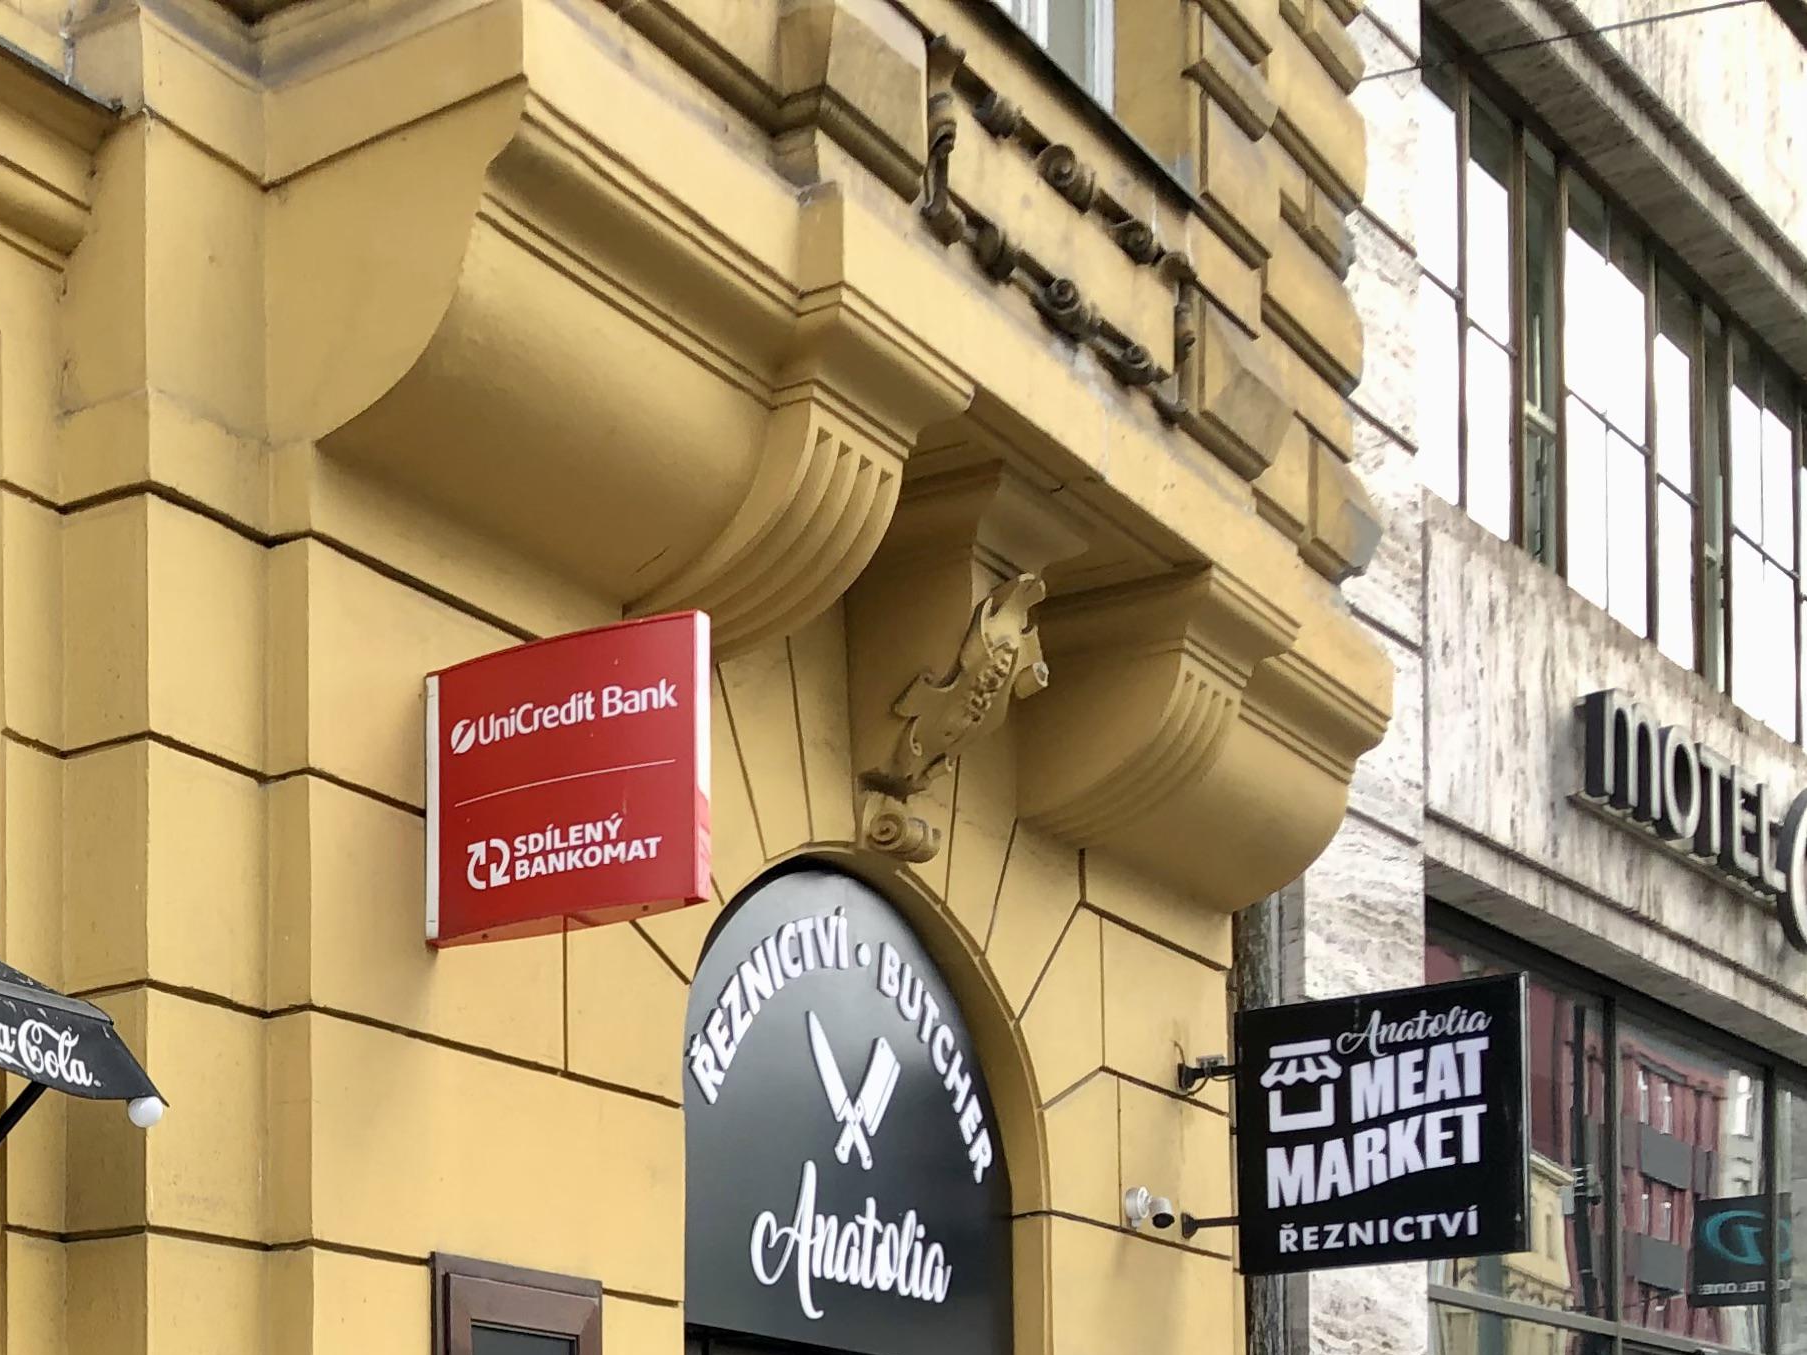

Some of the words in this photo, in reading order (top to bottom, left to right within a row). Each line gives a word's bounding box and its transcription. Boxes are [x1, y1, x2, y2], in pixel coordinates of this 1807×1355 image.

[479, 692, 595, 746] UniCredit
[601, 678, 679, 719] Bank
[513, 812, 624, 858] SDÍLENÝ
[514, 835, 663, 882] BANKOMAT
[685, 906, 850, 1105] ŘEZNICTVÍ
[877, 942, 993, 1184] BUTCHER
[1336, 1005, 1493, 1058] Anatolia
[1350, 1035, 1490, 1124] MEAT
[1265, 1103, 1488, 1210] MARKET
[749, 1160, 953, 1320] Anatolia
[1278, 1204, 1480, 1254] ŘEZNICTVÍ
